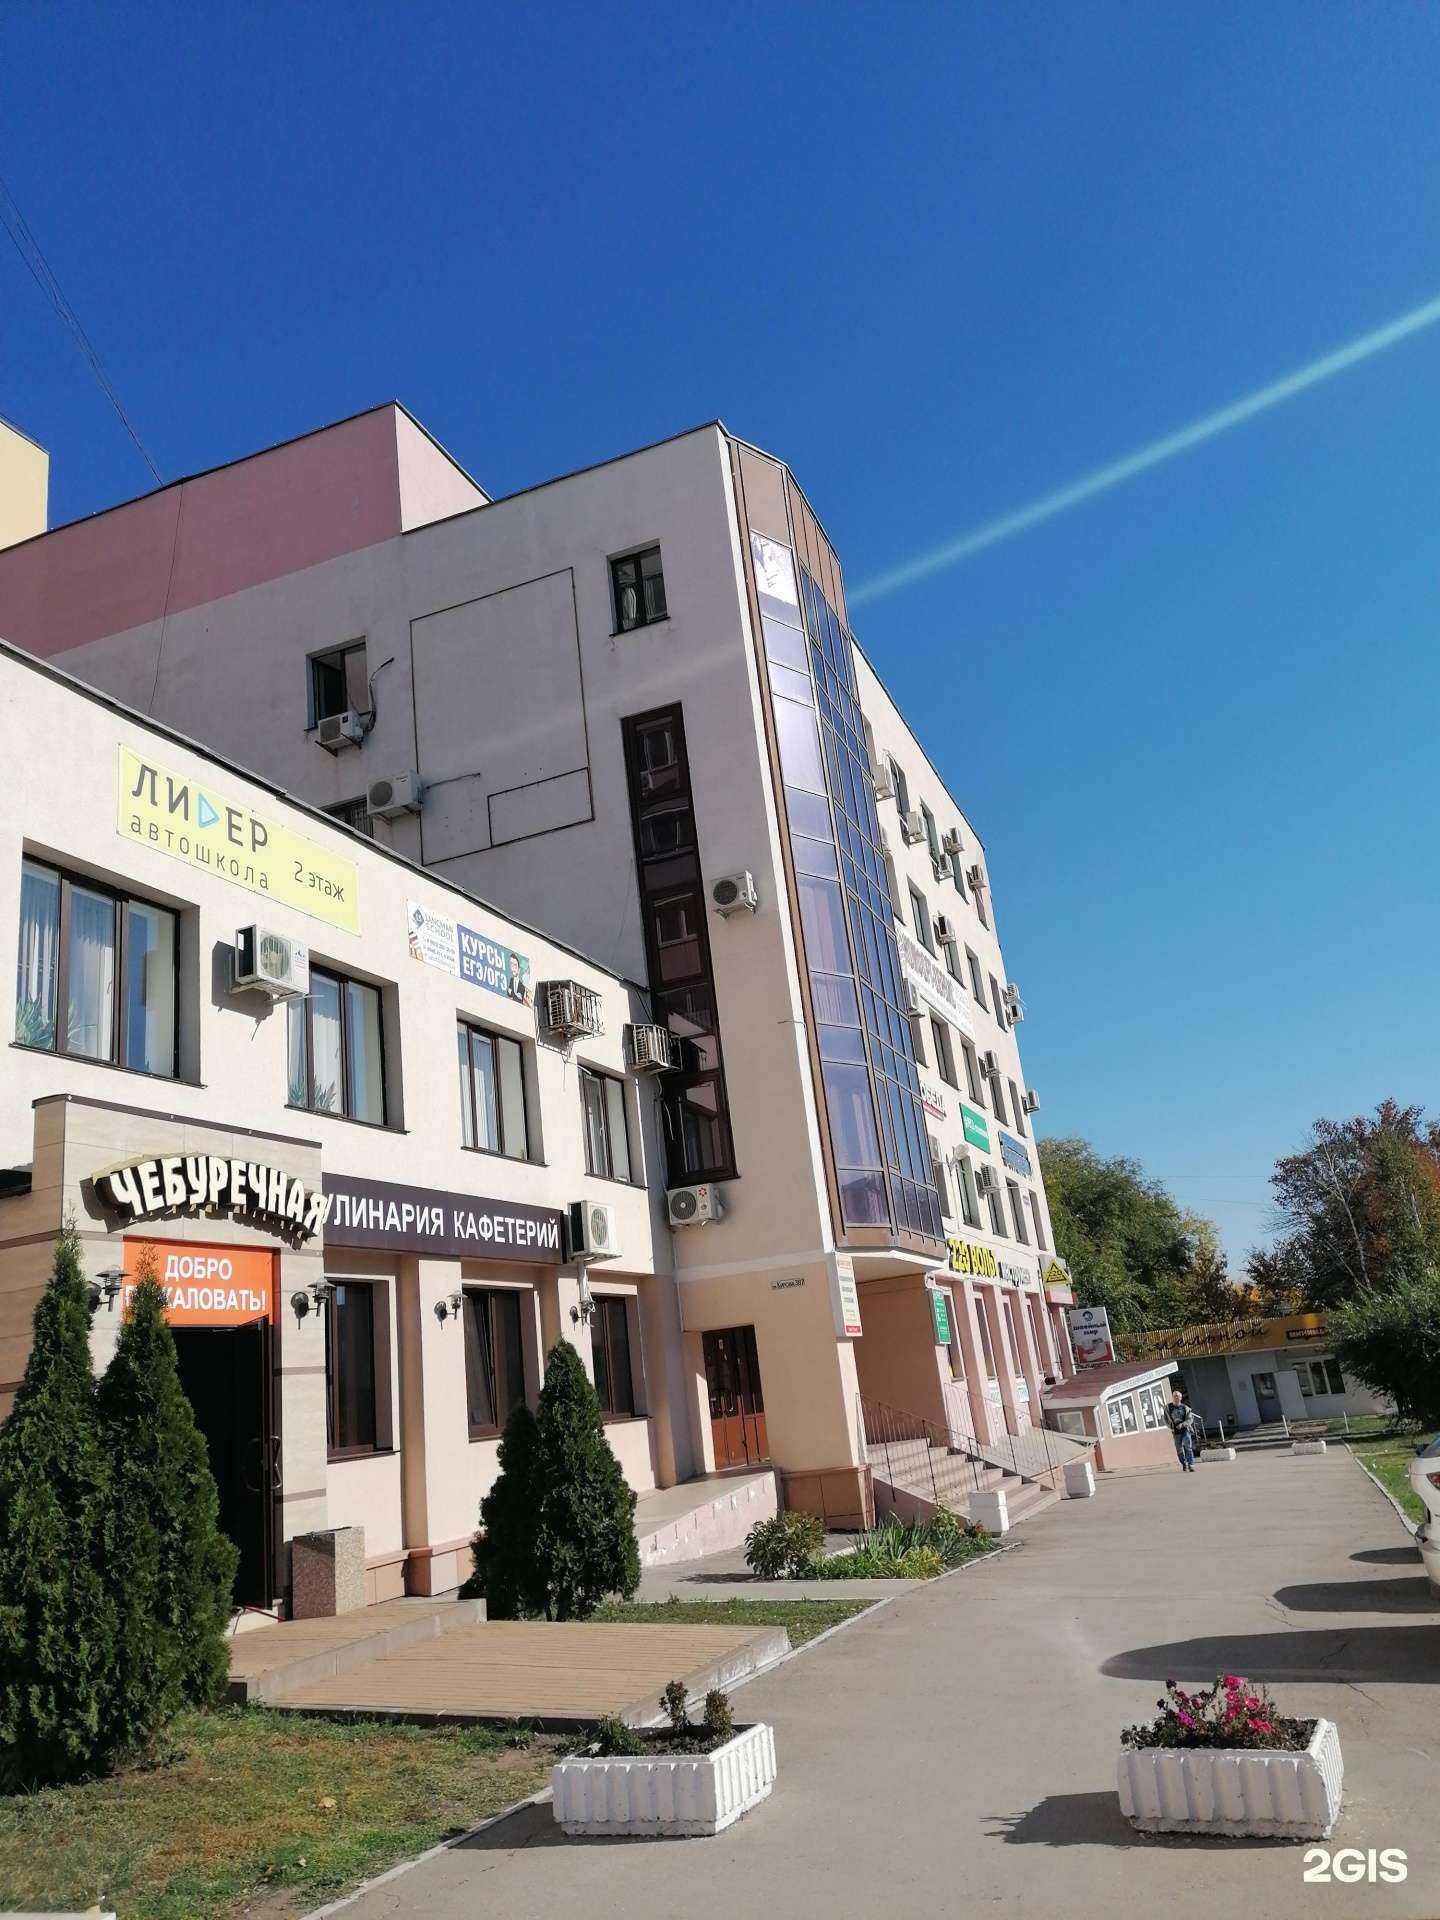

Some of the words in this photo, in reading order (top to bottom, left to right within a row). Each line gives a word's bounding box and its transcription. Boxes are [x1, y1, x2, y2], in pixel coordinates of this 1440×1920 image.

[130, 815, 269, 890] автошкола
[294, 861, 303, 883] 2
[308, 872, 345, 902] этаж
[461, 932, 506, 971] КУРСЫ
[463, 956, 508, 991] ЕГЭ/ОГЭ
[109, 1155, 328, 1237] ЧЕБУРЕЧНАЯ
[322, 1193, 444, 1237] УЛИНАРИЯ
[454, 1210, 559, 1250] КАФЕТЕРИЙ
[165, 1254, 233, 1282] ДОБРО
[125, 1284, 267, 1311] ПАЛОВАТЬ!
